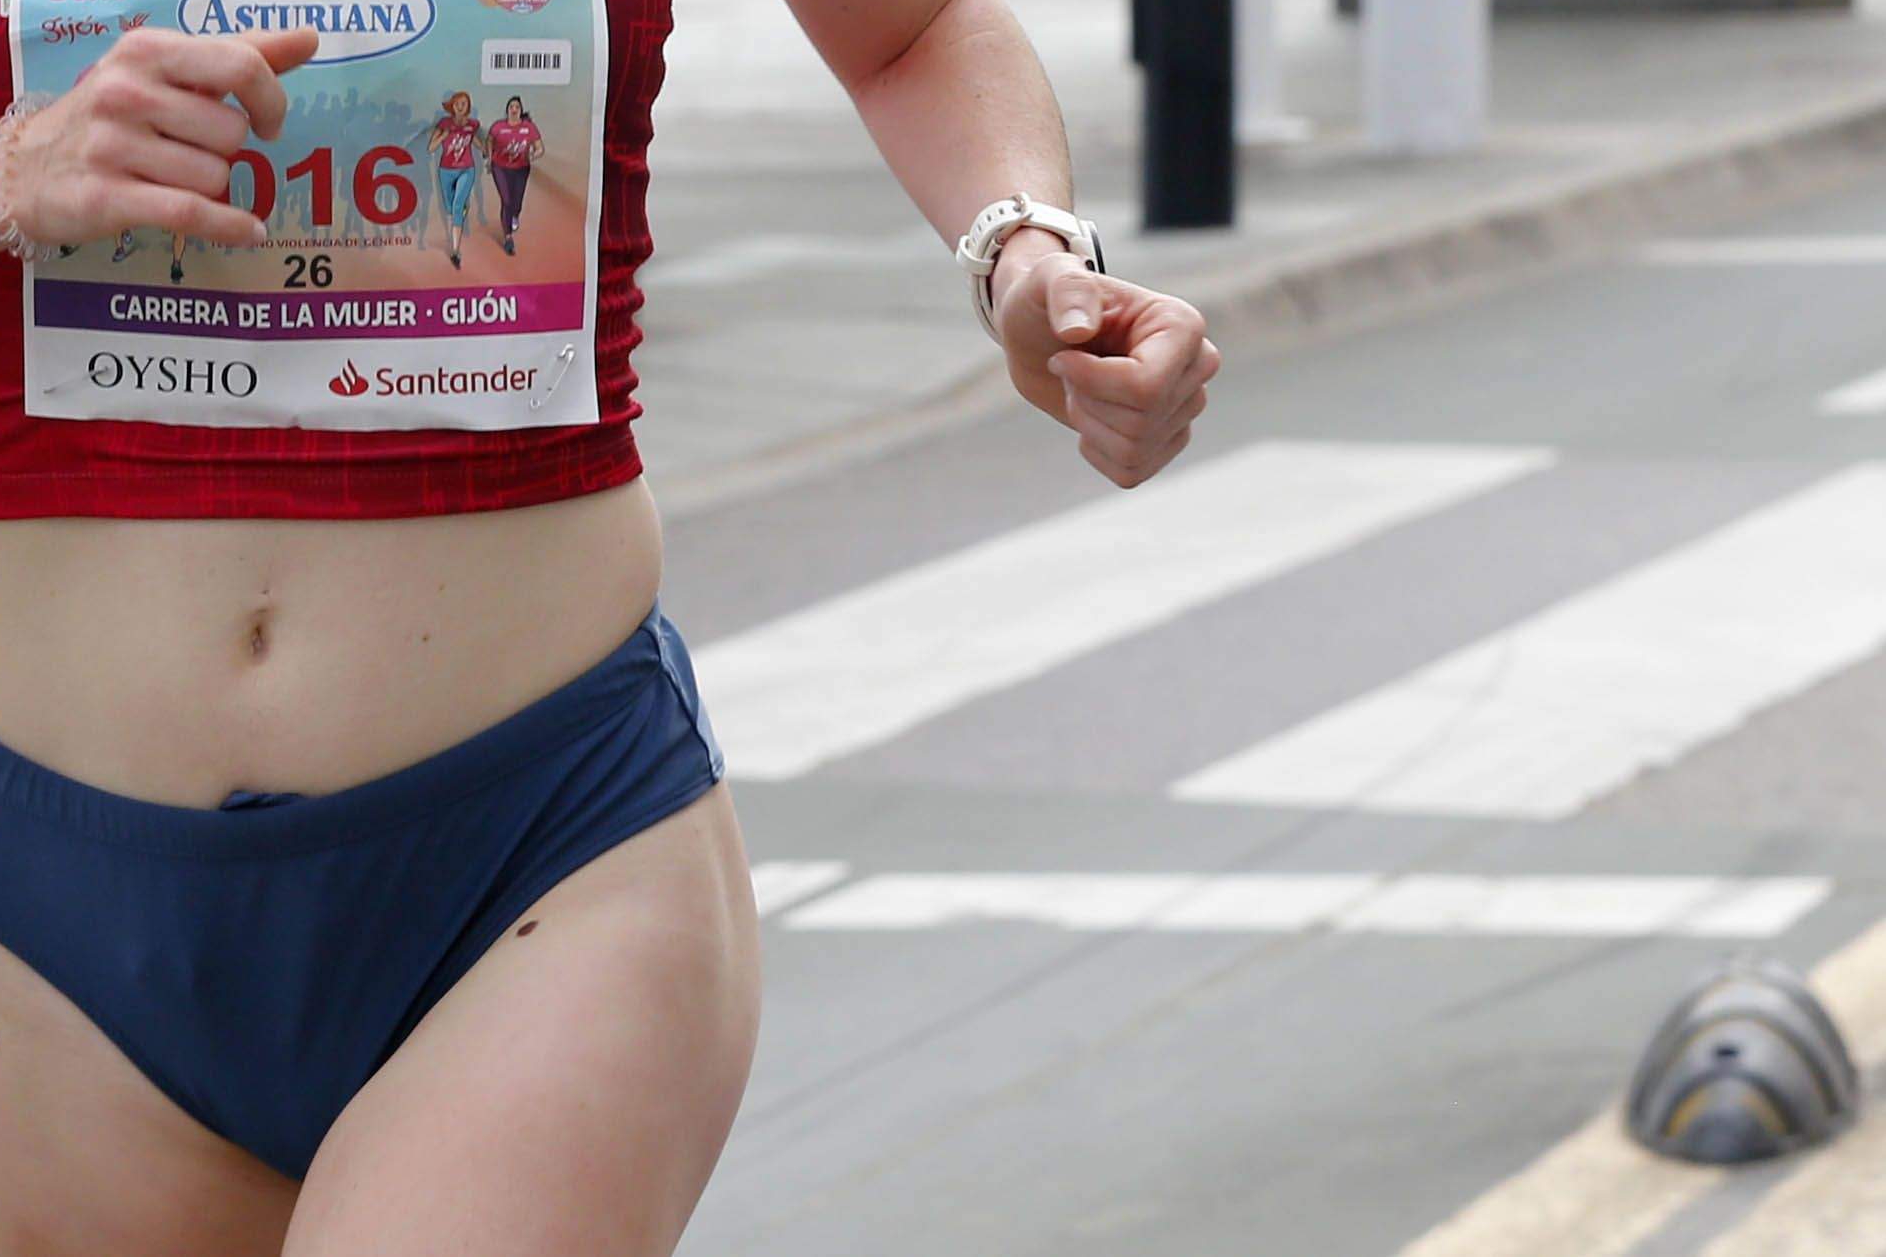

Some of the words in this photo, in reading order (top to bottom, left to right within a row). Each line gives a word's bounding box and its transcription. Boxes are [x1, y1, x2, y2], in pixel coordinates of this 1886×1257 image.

[42, 15, 110, 44] gijón
[283, 254, 334, 289] 26
[110, 294, 228, 327] CARRERA
[238, 303, 270, 328] DE
[281, 304, 314, 329] LA
[324, 301, 416, 327] MUJER
[442, 290, 517, 324] GIJÓN
[88, 351, 258, 398] OYSHO
[375, 364, 538, 396] Santander
